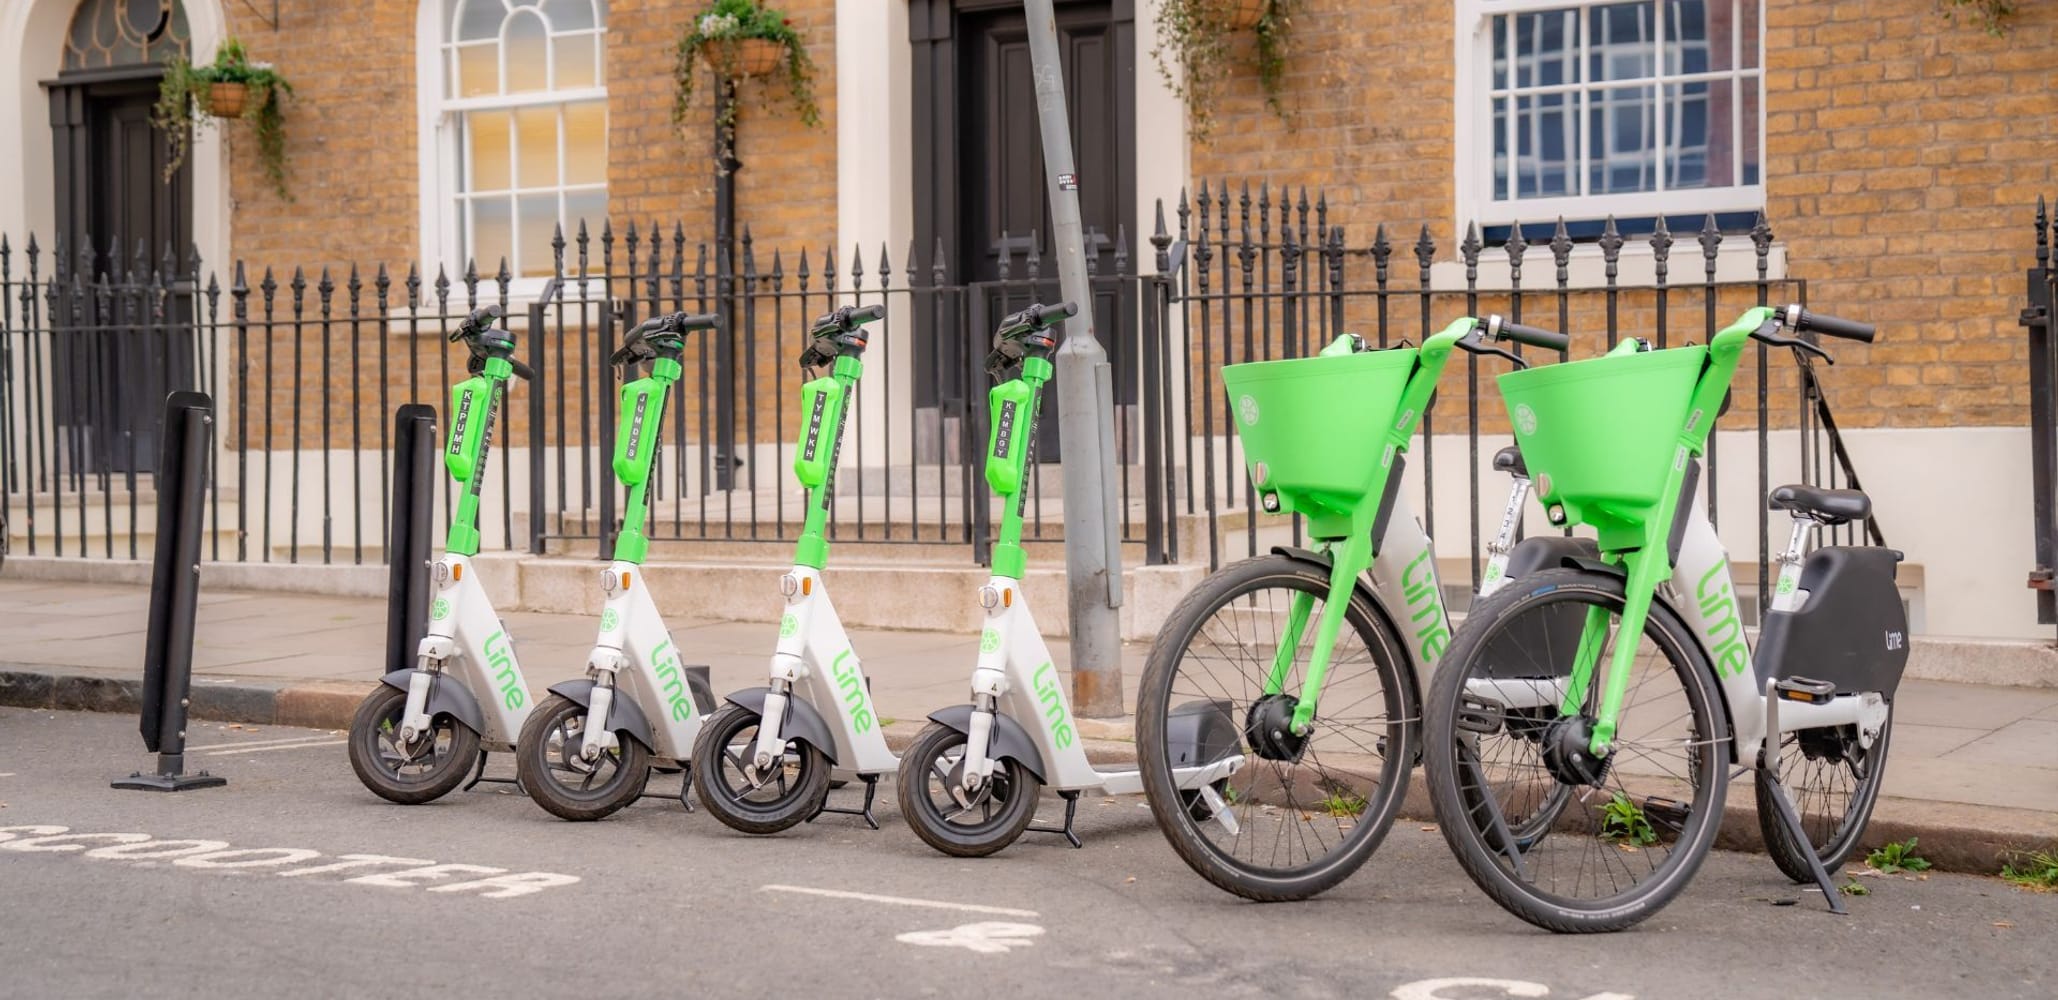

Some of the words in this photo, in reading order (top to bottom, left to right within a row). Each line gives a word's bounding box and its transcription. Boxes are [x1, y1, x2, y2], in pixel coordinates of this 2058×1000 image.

[451, 390, 472, 454] KTPUMH
[805, 393, 825, 458] TYMWKH
[1401, 549, 1450, 663] Lime
[1696, 558, 1747, 680] Lime
[484, 630, 524, 711] Lime
[651, 640, 691, 722] Lime
[832, 649, 872, 735] Lime
[1033, 661, 1072, 750] Lime
